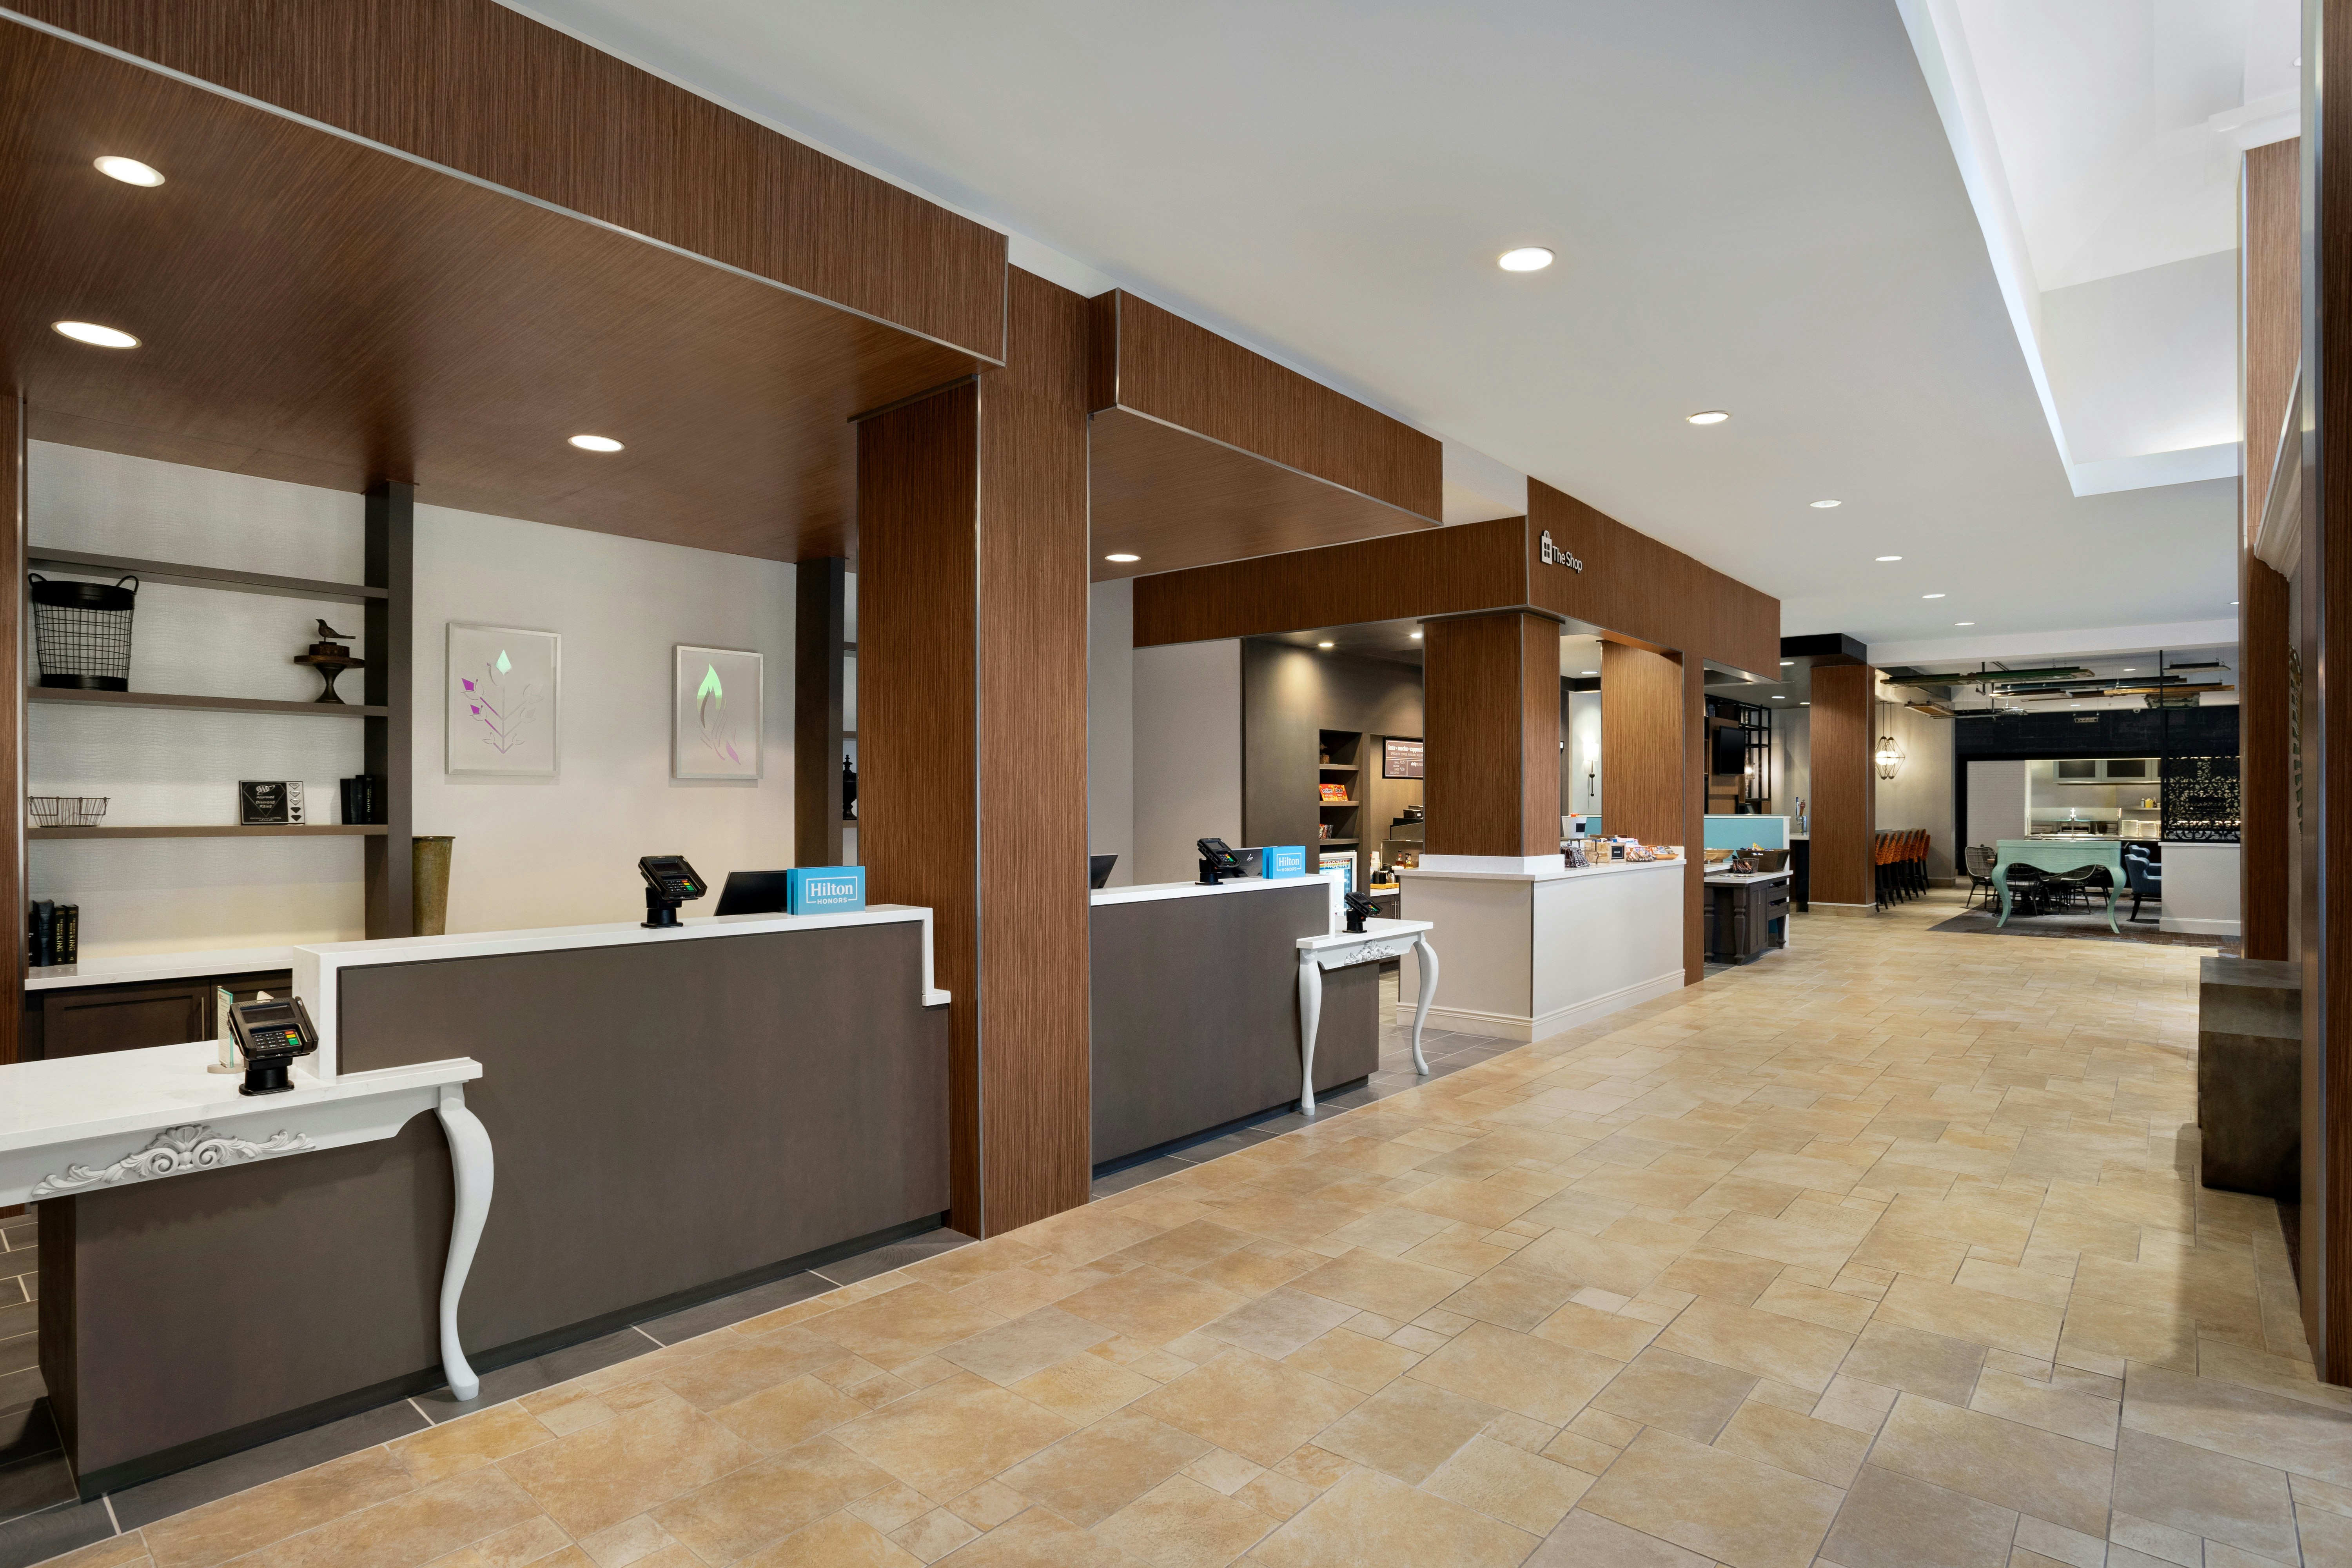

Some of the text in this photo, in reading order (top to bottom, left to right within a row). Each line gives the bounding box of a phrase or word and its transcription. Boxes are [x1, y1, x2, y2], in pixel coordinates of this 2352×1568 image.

[1552, 545, 1582, 573] The Shop
[1279, 857, 1299, 867] Hilton
[1324, 860, 1347, 869] FROZEN
[811, 882, 853, 897] Hilton
